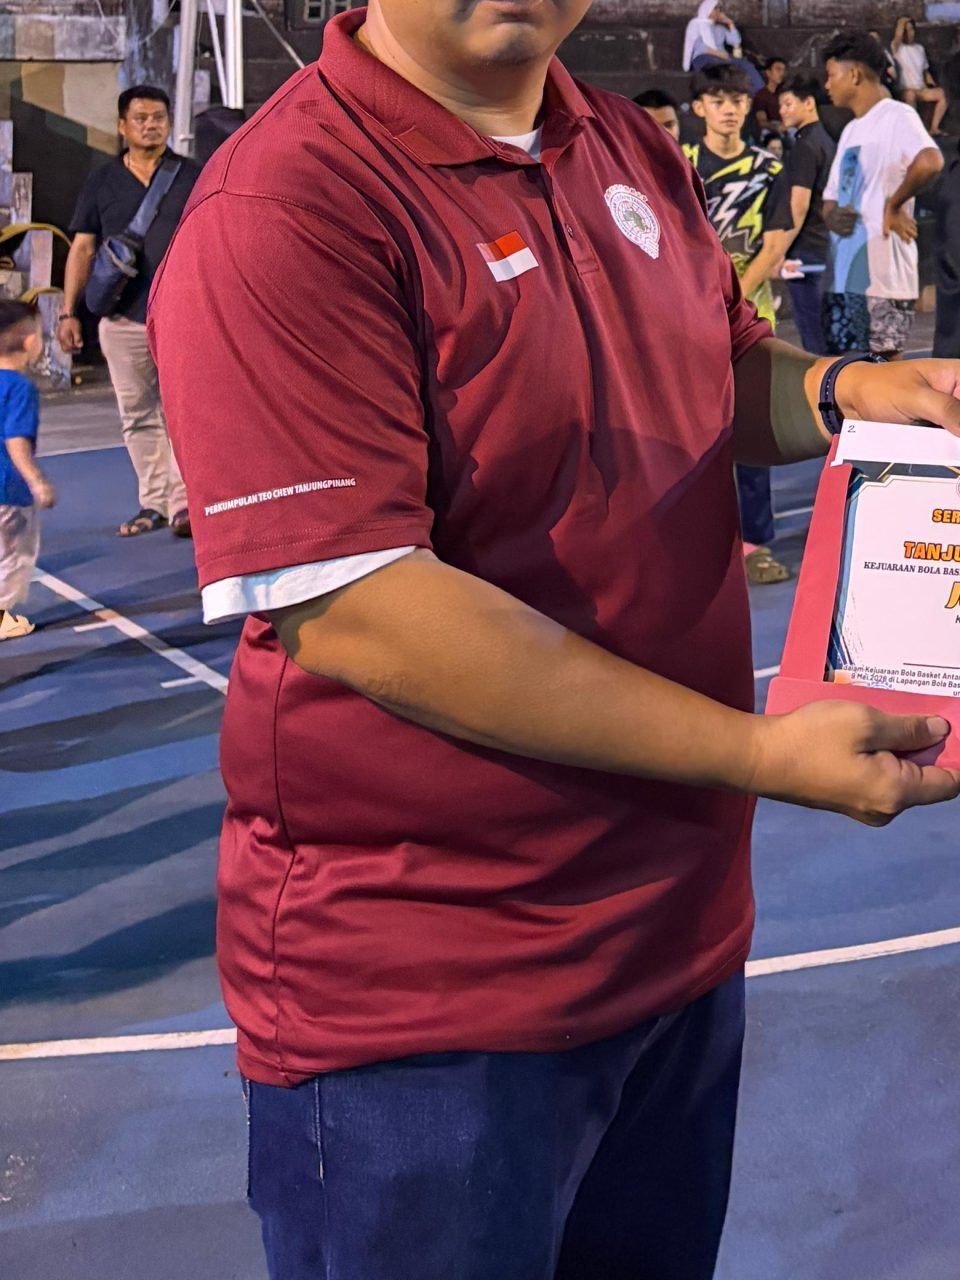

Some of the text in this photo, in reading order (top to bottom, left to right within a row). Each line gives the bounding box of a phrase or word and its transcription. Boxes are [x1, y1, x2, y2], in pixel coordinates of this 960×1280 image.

[848, 424, 856, 433] 2
[204, 478, 356, 517] PERKUMPULAN TEO CHEW TANJUNGPINANG
[863, 561, 916, 573] KEJUARAAN
[917, 565, 941, 575] BOLA
[843, 664, 864, 673] dalam
[865, 666, 899, 675] Kejuaraan
[900, 669, 916, 677] Bola
[917, 670, 941, 679] Basket
[857, 673, 869, 681] Mei
[896, 676, 929, 687] Lapangan
[931, 679, 947, 688] Bola
